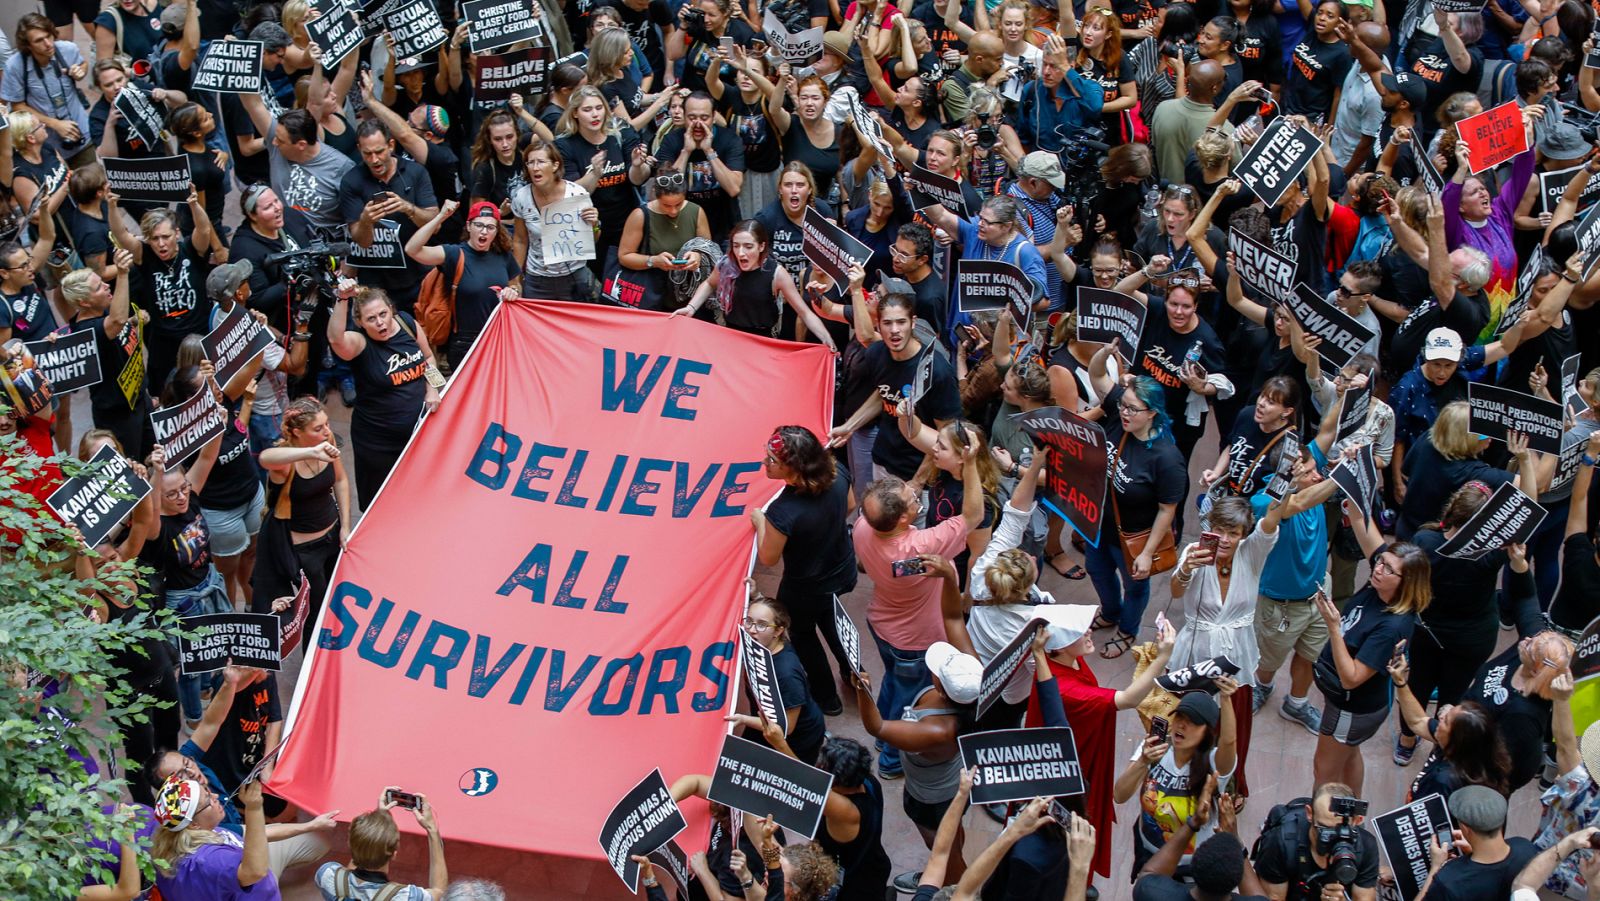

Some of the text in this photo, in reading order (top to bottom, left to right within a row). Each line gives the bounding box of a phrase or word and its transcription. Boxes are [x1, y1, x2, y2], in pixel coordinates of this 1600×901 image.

[388, 1, 430, 29] SEXUAL
[475, 9, 530, 30] BLASEY FORD
[478, 1, 523, 19] CHRISTINE
[313, 16, 330, 35] WE
[327, 21, 345, 43] NOT
[480, 26, 502, 40] 100%
[503, 18, 538, 35] CERTAIN
[770, 29, 811, 50] BELIEVE
[333, 28, 362, 56] SILENT
[404, 41, 414, 56] A
[227, 75, 259, 89] FORD
[481, 59, 545, 80] BELIEVE
[481, 73, 544, 90] SURVIVORS
[1476, 116, 1514, 140] BELIEVE
[1489, 137, 1508, 151] ALL
[106, 169, 190, 181] KAVANAUGH WAS A
[1263, 138, 1307, 189] OF LIES
[108, 180, 160, 190] DANGEROUS
[1243, 169, 1257, 188] A
[558, 225, 580, 240] at
[773, 230, 792, 240] My
[803, 221, 839, 255] KAVANAUGH
[351, 244, 395, 259] COVERUP
[1230, 233, 1292, 288] NEVER
[153, 266, 192, 290] BE A
[960, 273, 1032, 306] BRETT KAVANAUGH
[966, 285, 1006, 296] DEFINES
[25, 293, 41, 322] RESIST
[155, 288, 197, 316] HERO
[1091, 303, 1139, 329] KAVANAUGH
[215, 313, 252, 357] KAVANAUGH
[1078, 316, 1100, 328] LIED
[1103, 318, 1128, 338] UNDER
[1286, 291, 1365, 356] BEWARE
[227, 337, 248, 363] UNDER
[44, 360, 86, 384] UNFIT
[601, 347, 713, 422] WE
[1142, 354, 1182, 389] WOMEN
[1470, 397, 1563, 431] SEXUAL PREDATORS
[1473, 408, 1559, 440] MUST BE STOPPED
[163, 408, 222, 462] WHITEWASH
[1024, 417, 1099, 448] WOMEN
[1036, 432, 1085, 461] MUST
[465, 422, 762, 519] BELIEVE
[1050, 475, 1099, 524] HEARD
[81, 509, 100, 528] IS
[1474, 490, 1526, 543] KAVANAUGH
[1501, 505, 1532, 537] HUBRIS
[496, 543, 630, 614] ALL
[183, 646, 280, 663] IS 100% CERTAIN
[190, 635, 270, 651] BLASEY FORD
[317, 580, 735, 717] SURVIVORS
[754, 648, 769, 682] HILL
[981, 647, 1021, 693] KAVANAUGH
[976, 743, 1063, 766] KAVANAUGH
[719, 755, 823, 806] THE FBI INVESTIGATION
[985, 760, 1078, 785] BELLIGERENT
[731, 773, 805, 811] IS A WHITEWASH
[607, 786, 669, 866] KAVANAUGH WAS A
[1410, 802, 1434, 836] BRETT
[614, 798, 677, 879] DANGEROUS DRUNK
[1395, 815, 1421, 860] DEFINES
